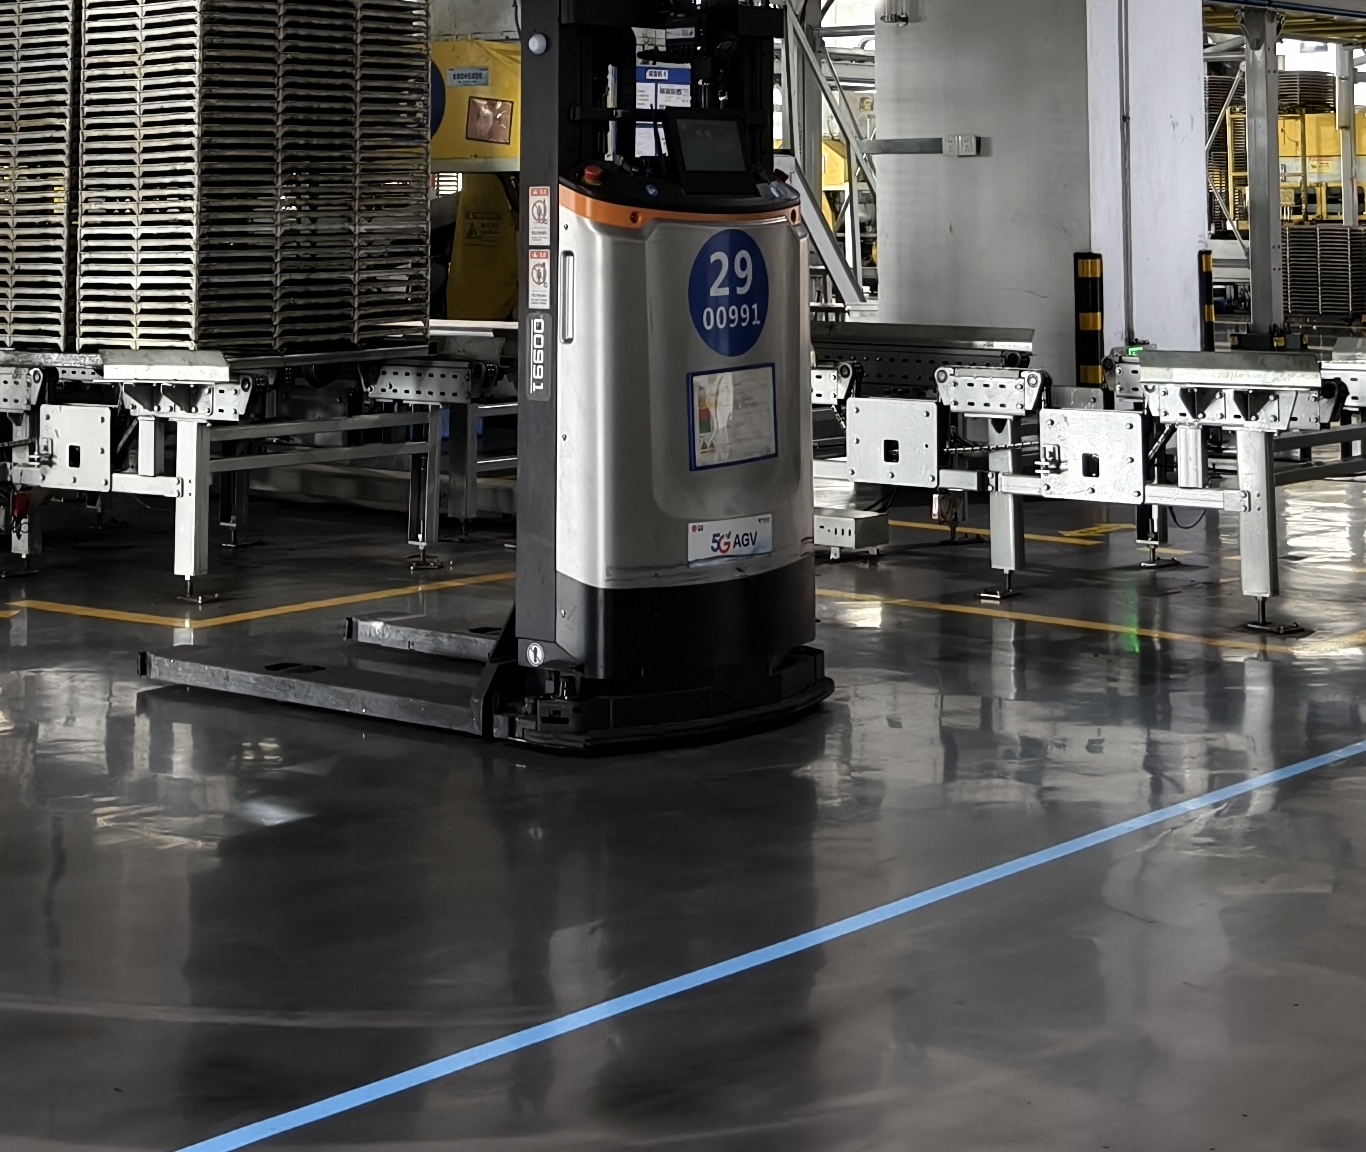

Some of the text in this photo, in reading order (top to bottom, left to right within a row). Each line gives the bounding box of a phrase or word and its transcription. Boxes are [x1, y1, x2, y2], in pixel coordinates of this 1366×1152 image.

[709, 249, 753, 297] 29
[702, 302, 761, 331] 00991
[532, 318, 545, 392] 00991
[733, 530, 758, 549] AGV
